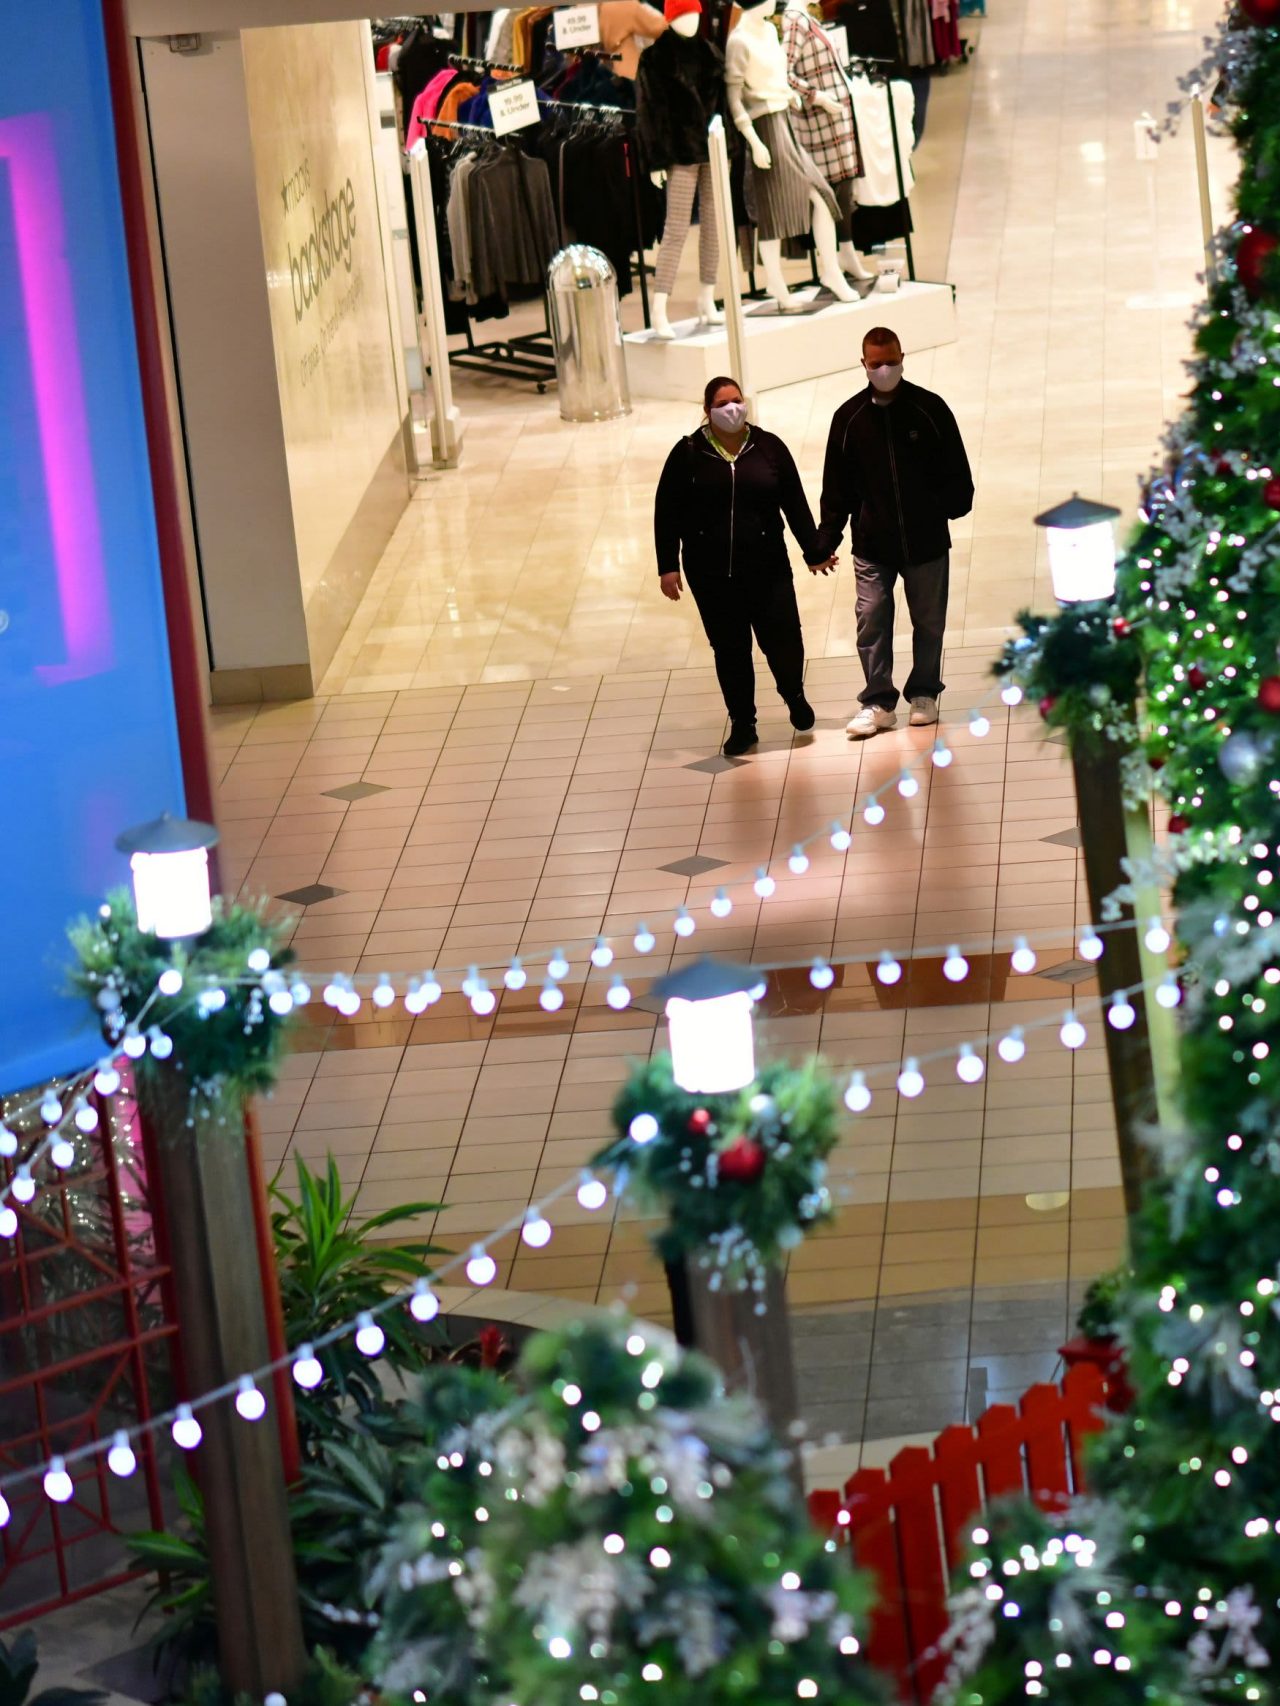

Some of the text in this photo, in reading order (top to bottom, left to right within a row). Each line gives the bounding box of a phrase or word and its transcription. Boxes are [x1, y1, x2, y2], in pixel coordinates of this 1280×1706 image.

[570, 24, 592, 34] Under
[508, 102, 529, 114] Under
[287, 177, 356, 326] backstage
